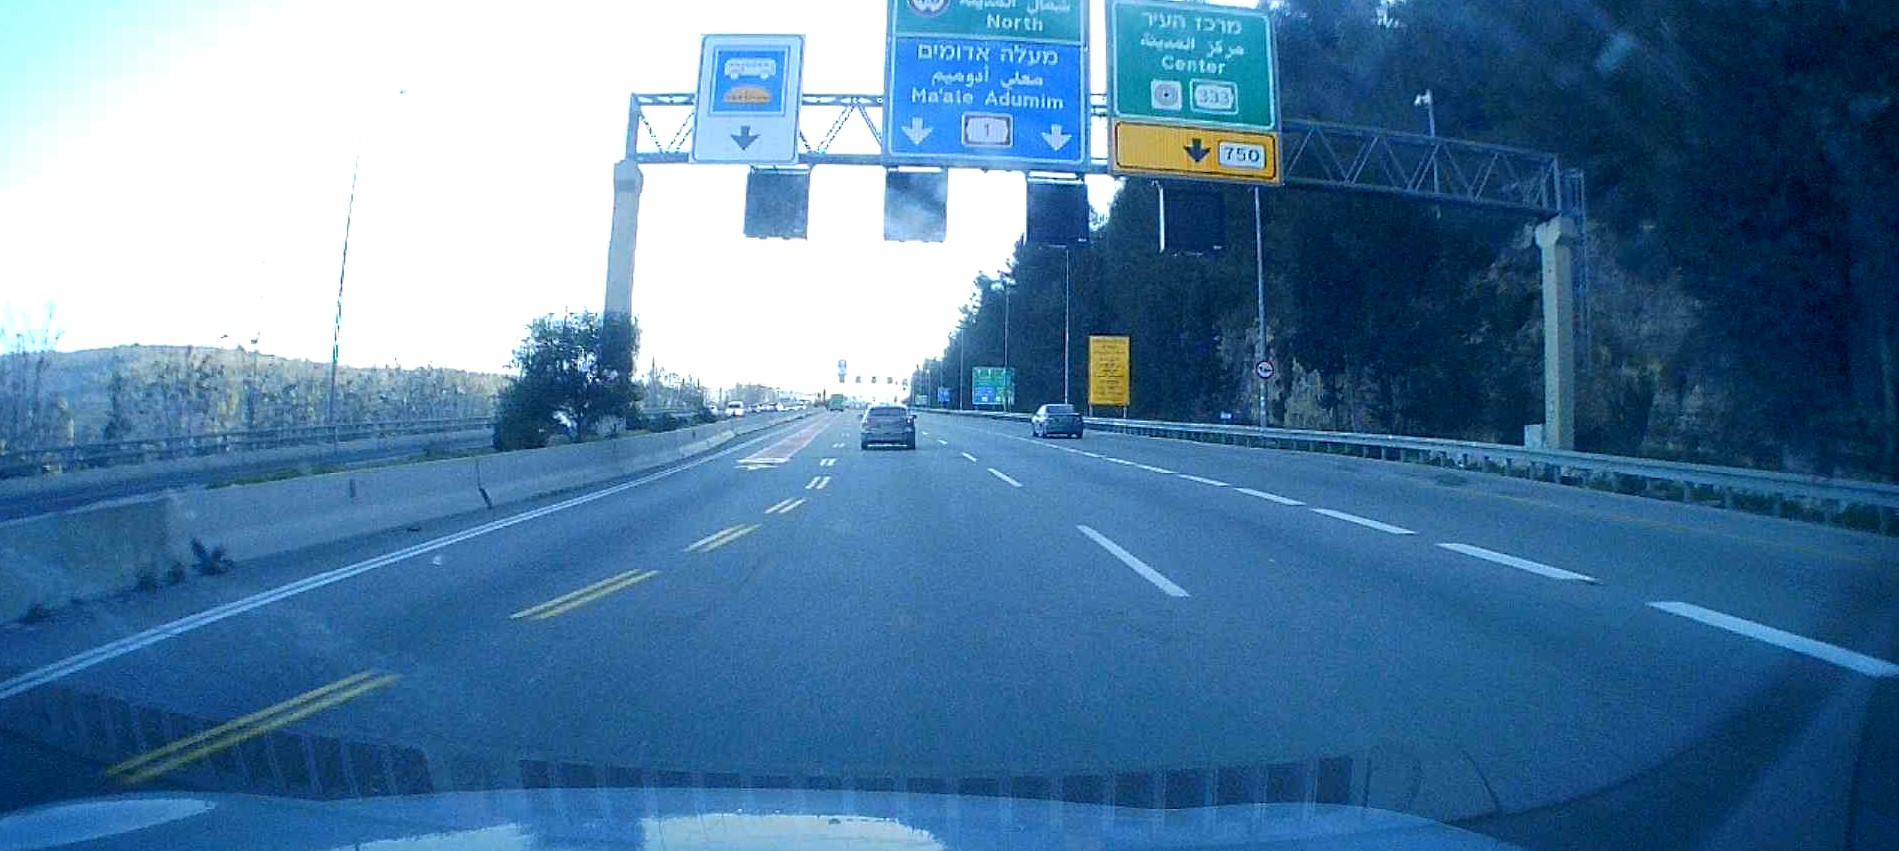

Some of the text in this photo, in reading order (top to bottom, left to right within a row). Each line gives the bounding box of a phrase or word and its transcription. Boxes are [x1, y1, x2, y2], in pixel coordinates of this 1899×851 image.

[986, 14, 1044, 31] North
[1141, 12, 1243, 35] מרכז העיר
[917, 44, 1059, 65] מעלה אדומים
[1161, 55, 1226, 74] Center
[911, 87, 1064, 109] Ma'ale Adumim
[1224, 147, 1260, 163] 750
